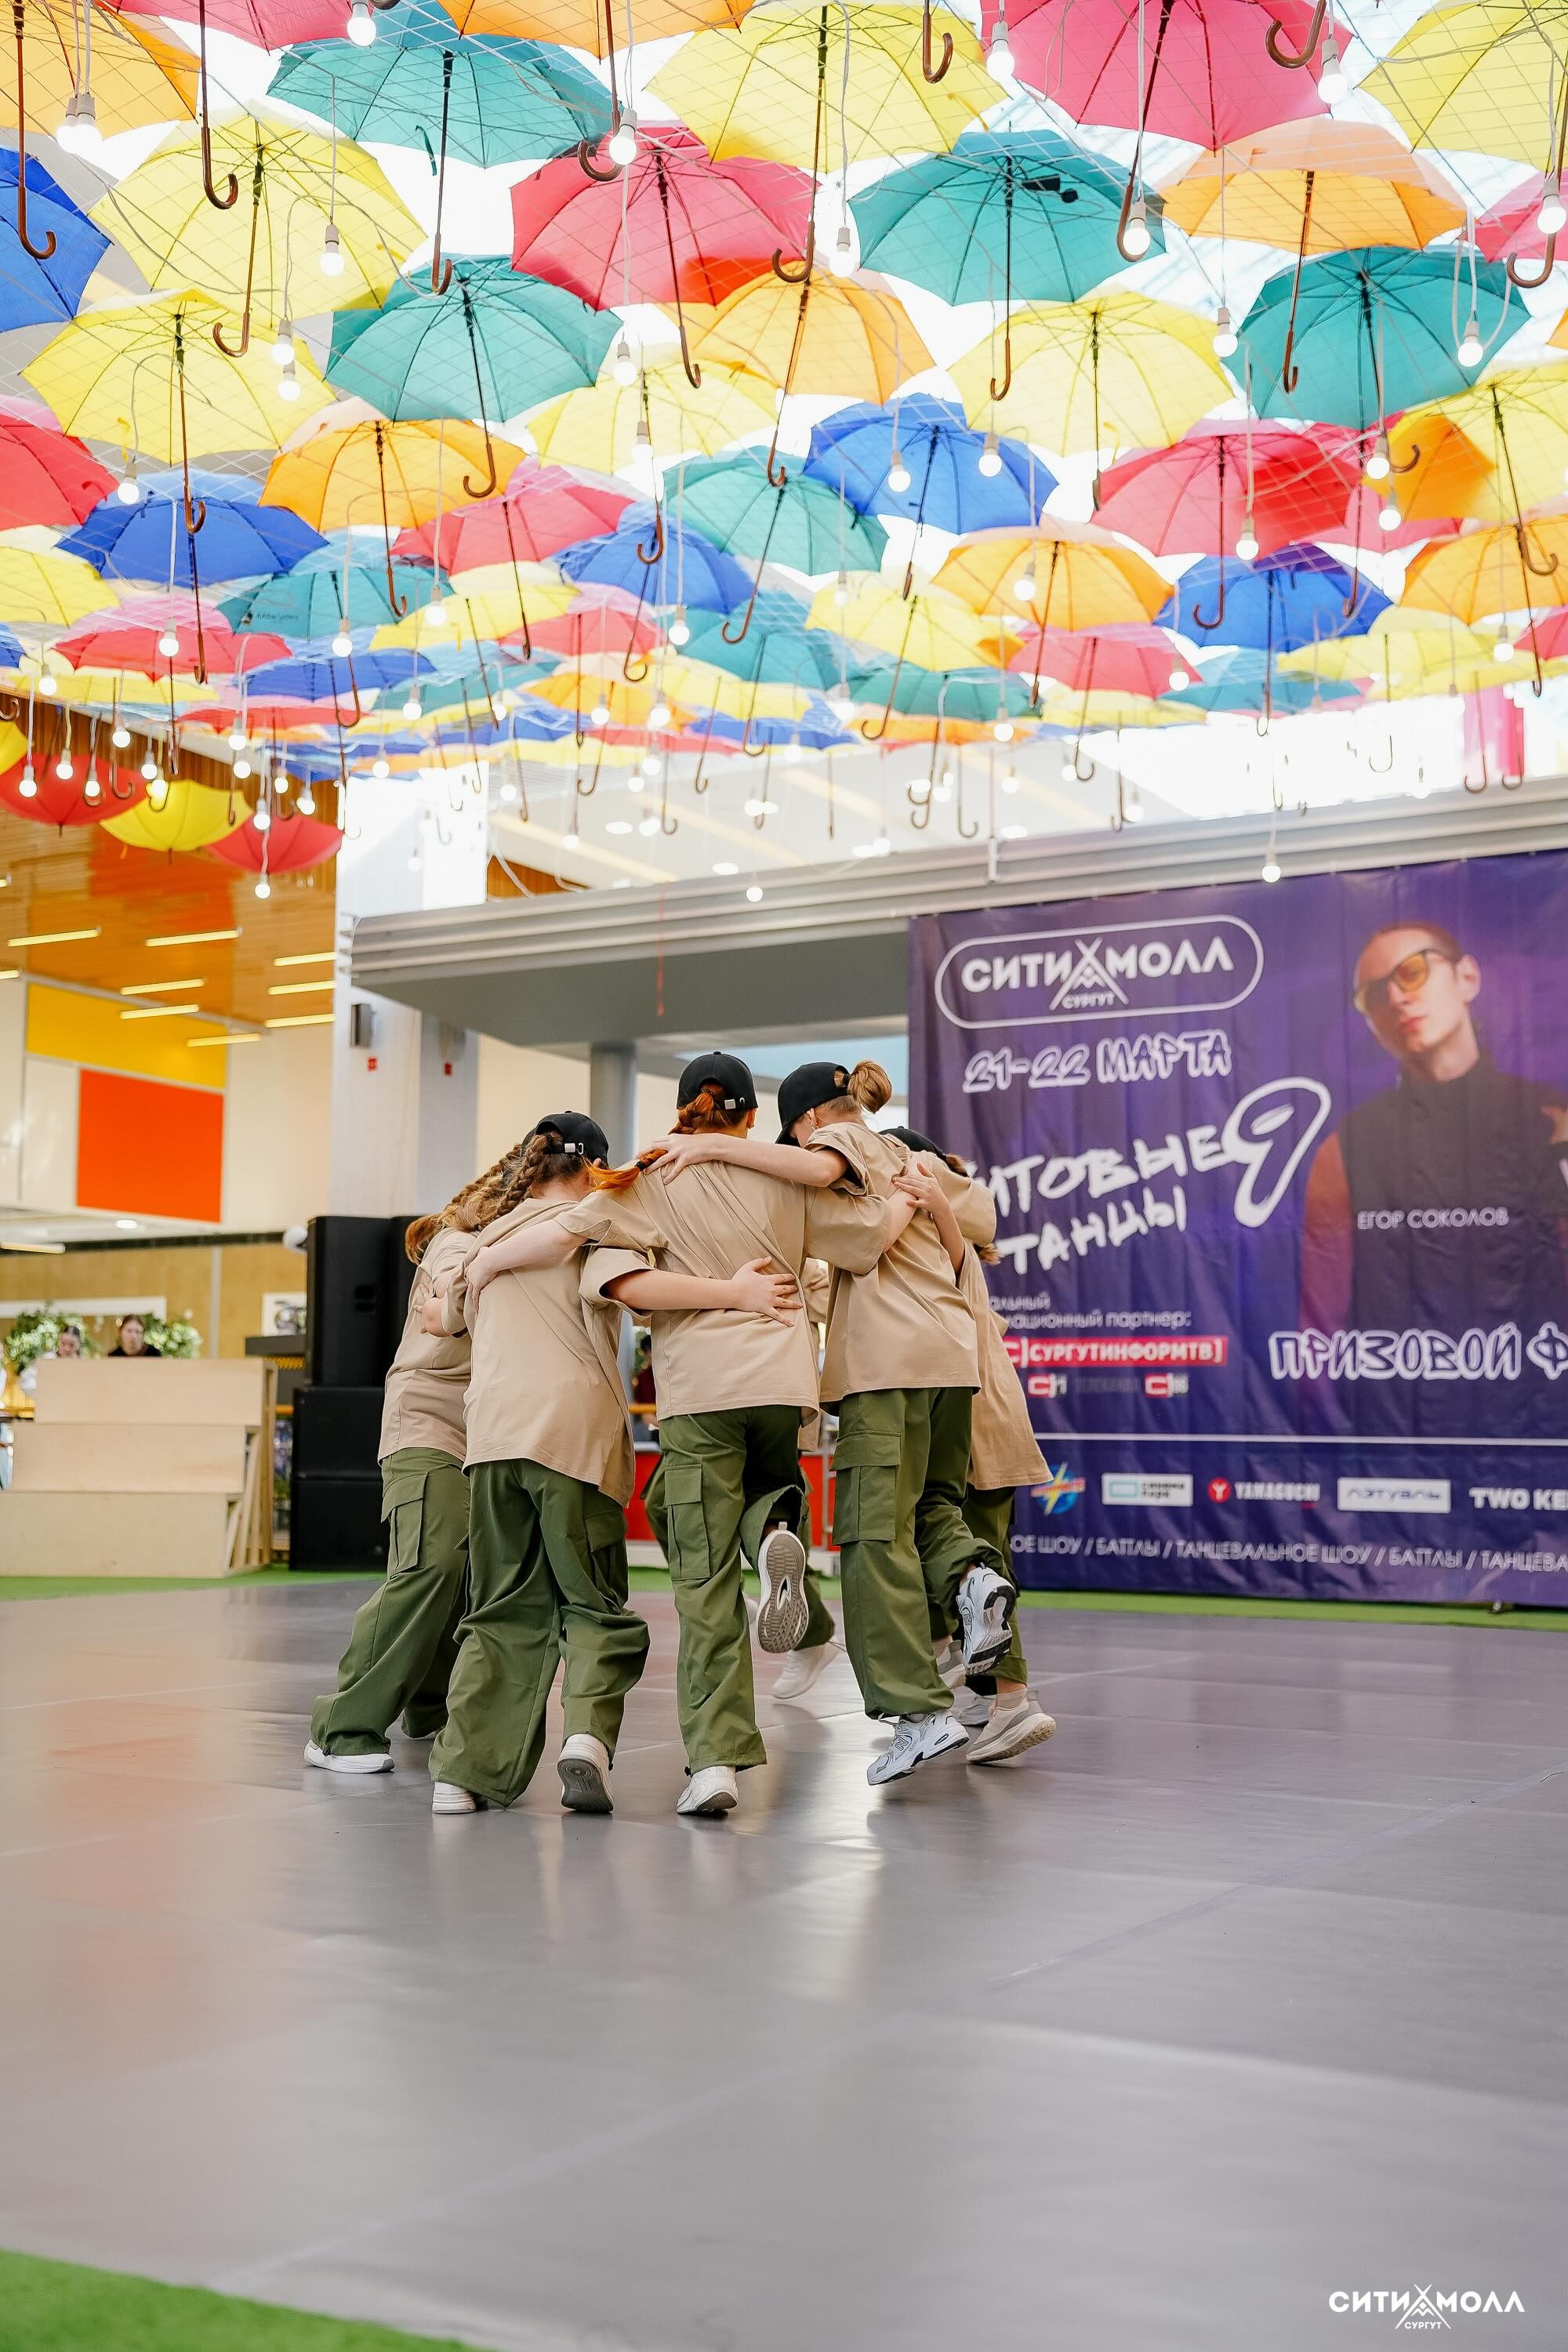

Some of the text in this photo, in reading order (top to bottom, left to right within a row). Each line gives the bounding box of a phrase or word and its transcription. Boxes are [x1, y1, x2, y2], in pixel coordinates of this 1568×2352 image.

[1062, 990, 1117, 1010] СУРГУТ
[962, 1029, 1232, 1094] 21-22 МАРТА
[965, 1124, 1228, 1217] ИТОВЫЕ
[996, 1185, 1187, 1275] ТАНЦЫ
[1357, 1207, 1510, 1230] ЕГОР СОКОЛОВ
[1268, 1322, 1522, 1381] ПРИЗОВОЙ
[1468, 1487, 1530, 1510] TWO
[1037, 1536, 1082, 1555] ШОУ
[1096, 1536, 1161, 1558] БАТТЛЫ
[1176, 1537, 1320, 1563] ТАНЦЕВАЛЬНОЕ
[1322, 1544, 1372, 1565] ШОУ
[1388, 1547, 1464, 1569] БАТТЛЫ
